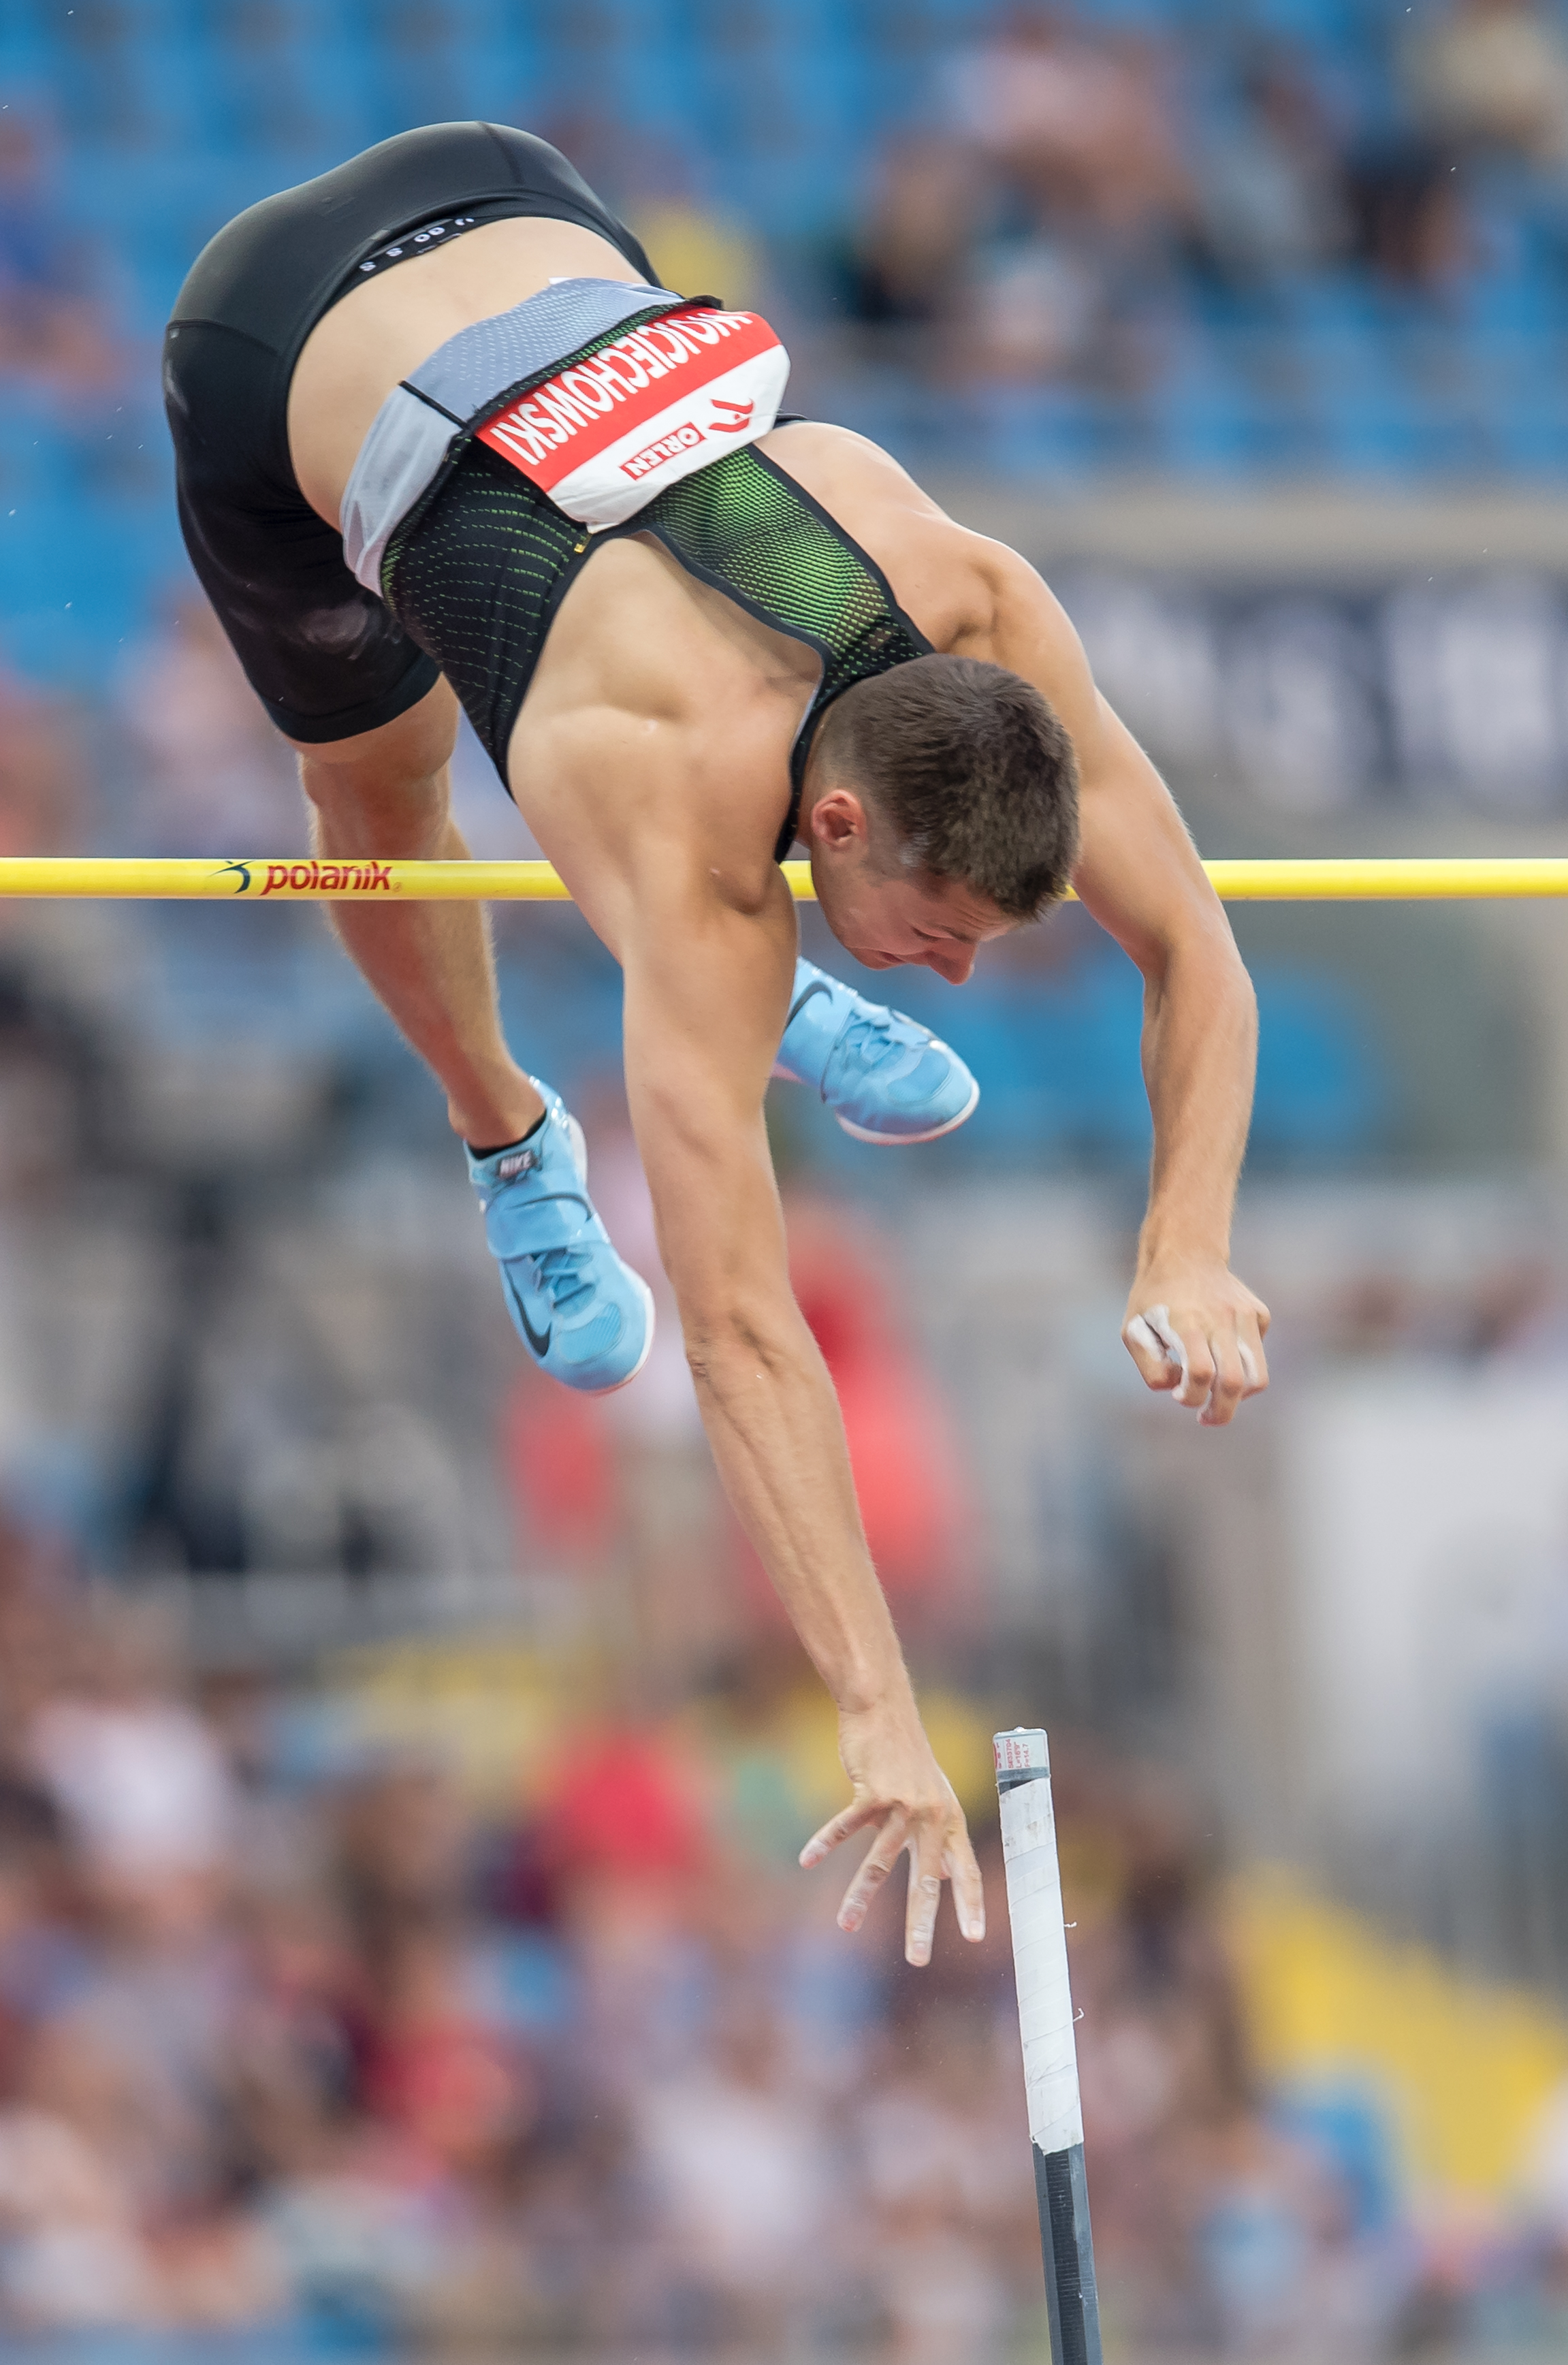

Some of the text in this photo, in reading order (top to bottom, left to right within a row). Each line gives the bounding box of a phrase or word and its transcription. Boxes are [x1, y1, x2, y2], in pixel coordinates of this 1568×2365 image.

[490, 313, 754, 466] WOJCIECHOWSKI
[626, 425, 701, 477] ORLEN
[259, 860, 394, 896] polanik
